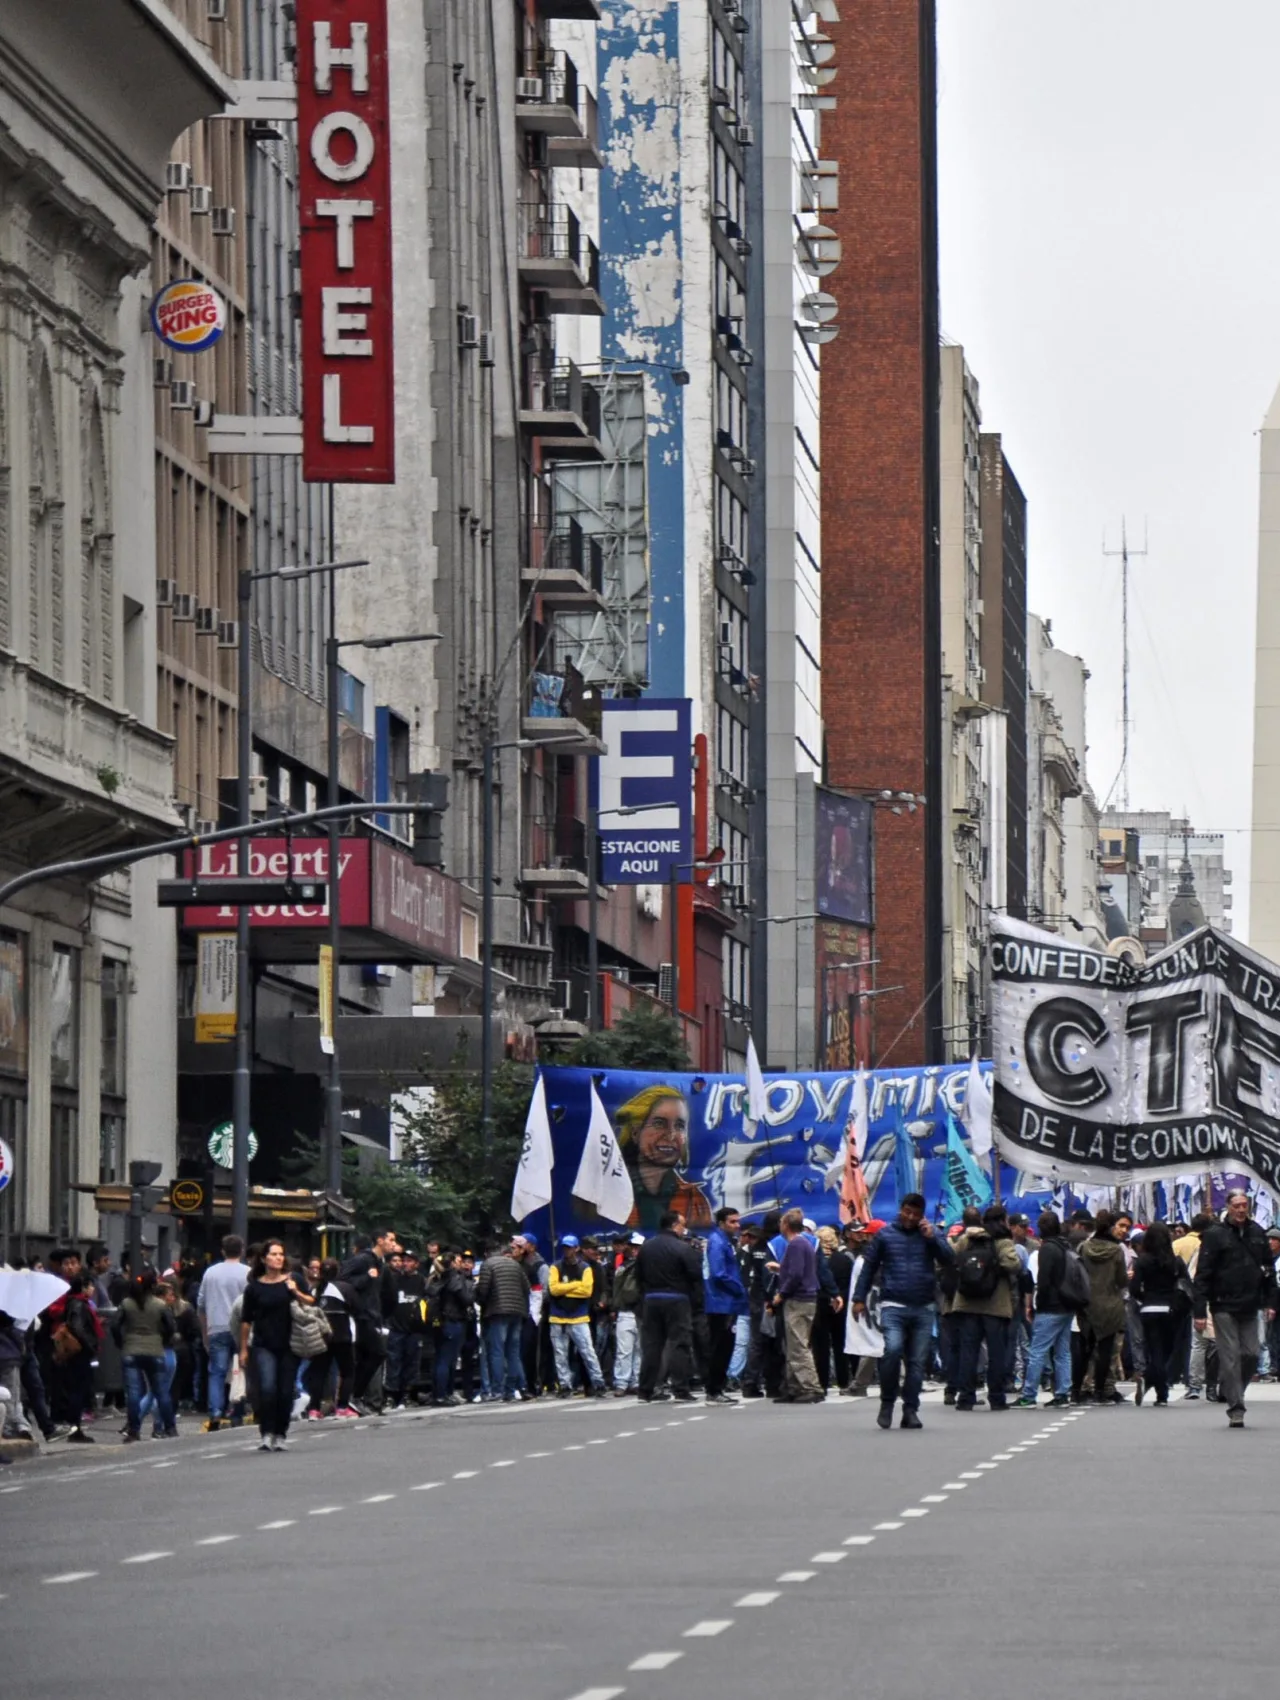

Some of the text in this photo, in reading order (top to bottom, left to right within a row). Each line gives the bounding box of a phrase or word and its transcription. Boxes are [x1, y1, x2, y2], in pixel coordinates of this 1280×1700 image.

[310, 20, 375, 445] HOTEL
[158, 293, 214, 320] BURGER
[160, 305, 217, 337] KING
[599, 710, 680, 830] E
[198, 843, 353, 880] Liberty
[601, 839, 681, 854] ESTACIONE
[620, 859, 659, 874] AQUI
[1204, 936, 1229, 978] DE
[1020, 1107, 1060, 1149] DE
[1069, 1125, 1104, 1160] LA
